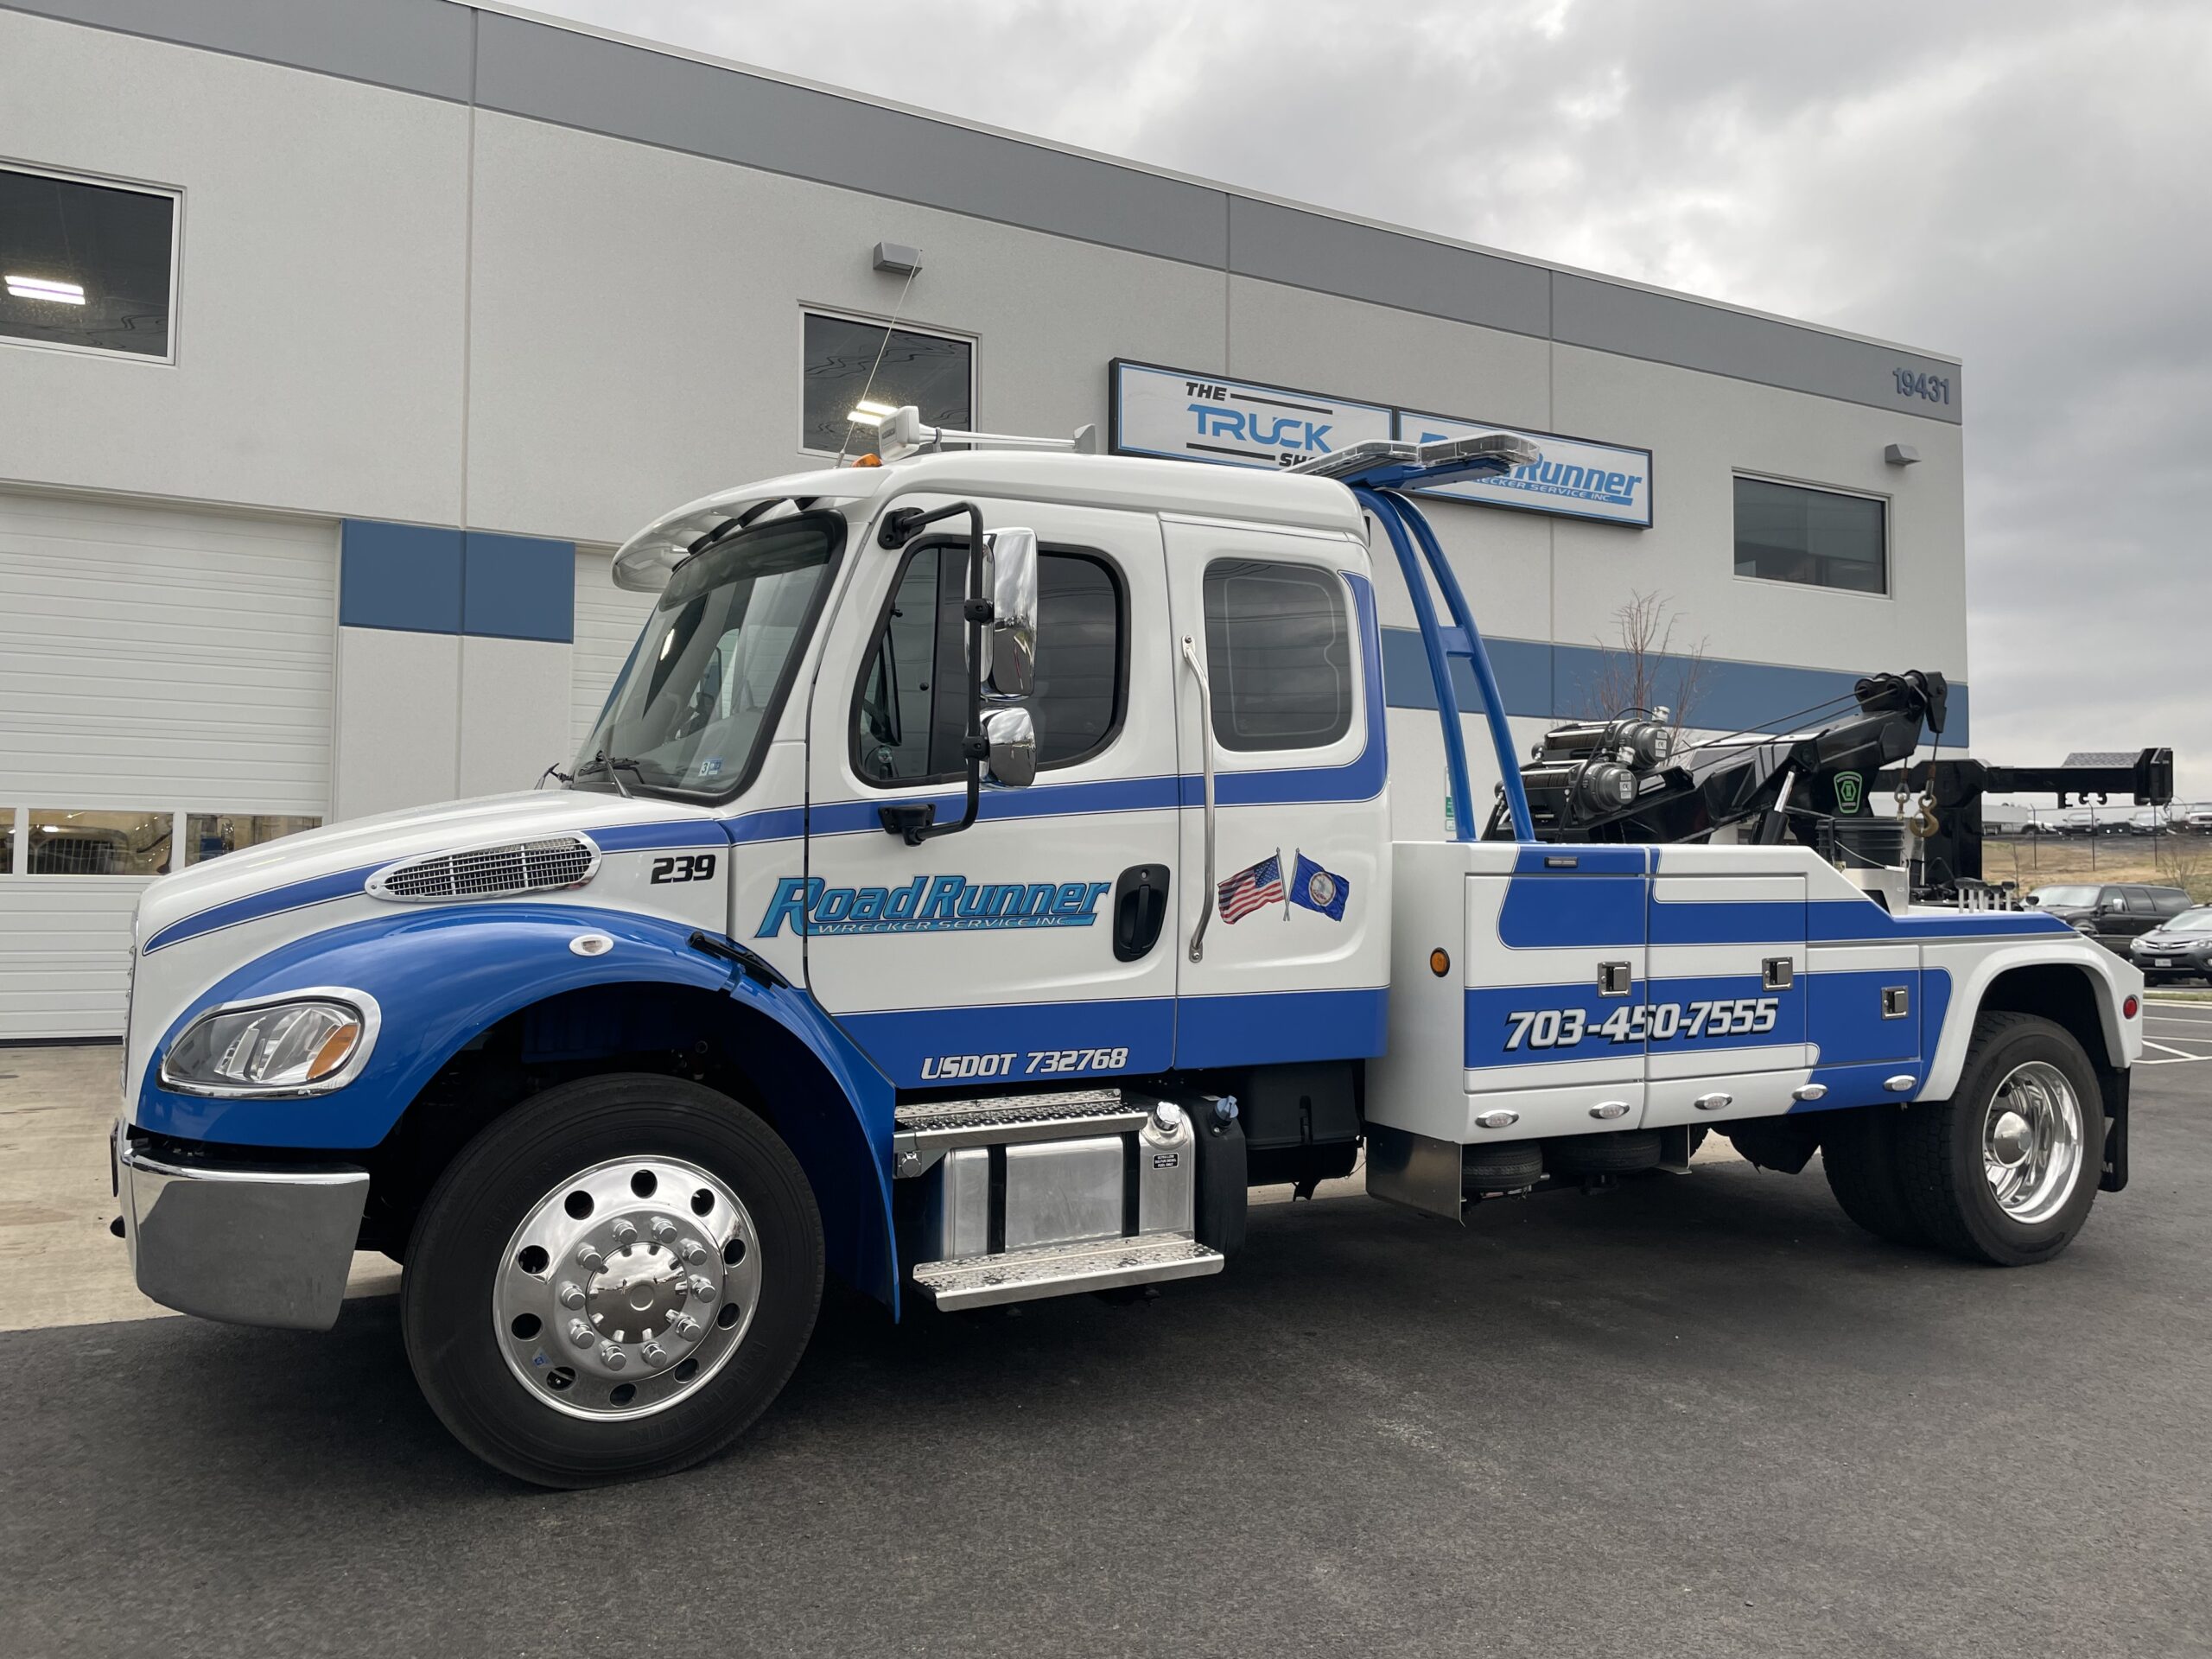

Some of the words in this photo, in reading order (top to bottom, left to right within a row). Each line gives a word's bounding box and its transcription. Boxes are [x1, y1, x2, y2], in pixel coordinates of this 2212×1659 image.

[1185, 381, 1228, 402] THE
[1892, 367, 1949, 404] 19431
[1186, 404, 1334, 454] TRUCK
[1529, 483, 1587, 499] SERVICE
[1591, 493, 1613, 503] INC.
[651, 854, 716, 885] 239
[753, 875, 1112, 938] RoadRunner
[817, 919, 931, 934] WRECKER
[938, 918, 1031, 930] SERVICE
[1503, 997, 1779, 1052] 703-450-7555
[921, 1052, 1018, 1080] USDOT
[1024, 1047, 1129, 1075] 732768
